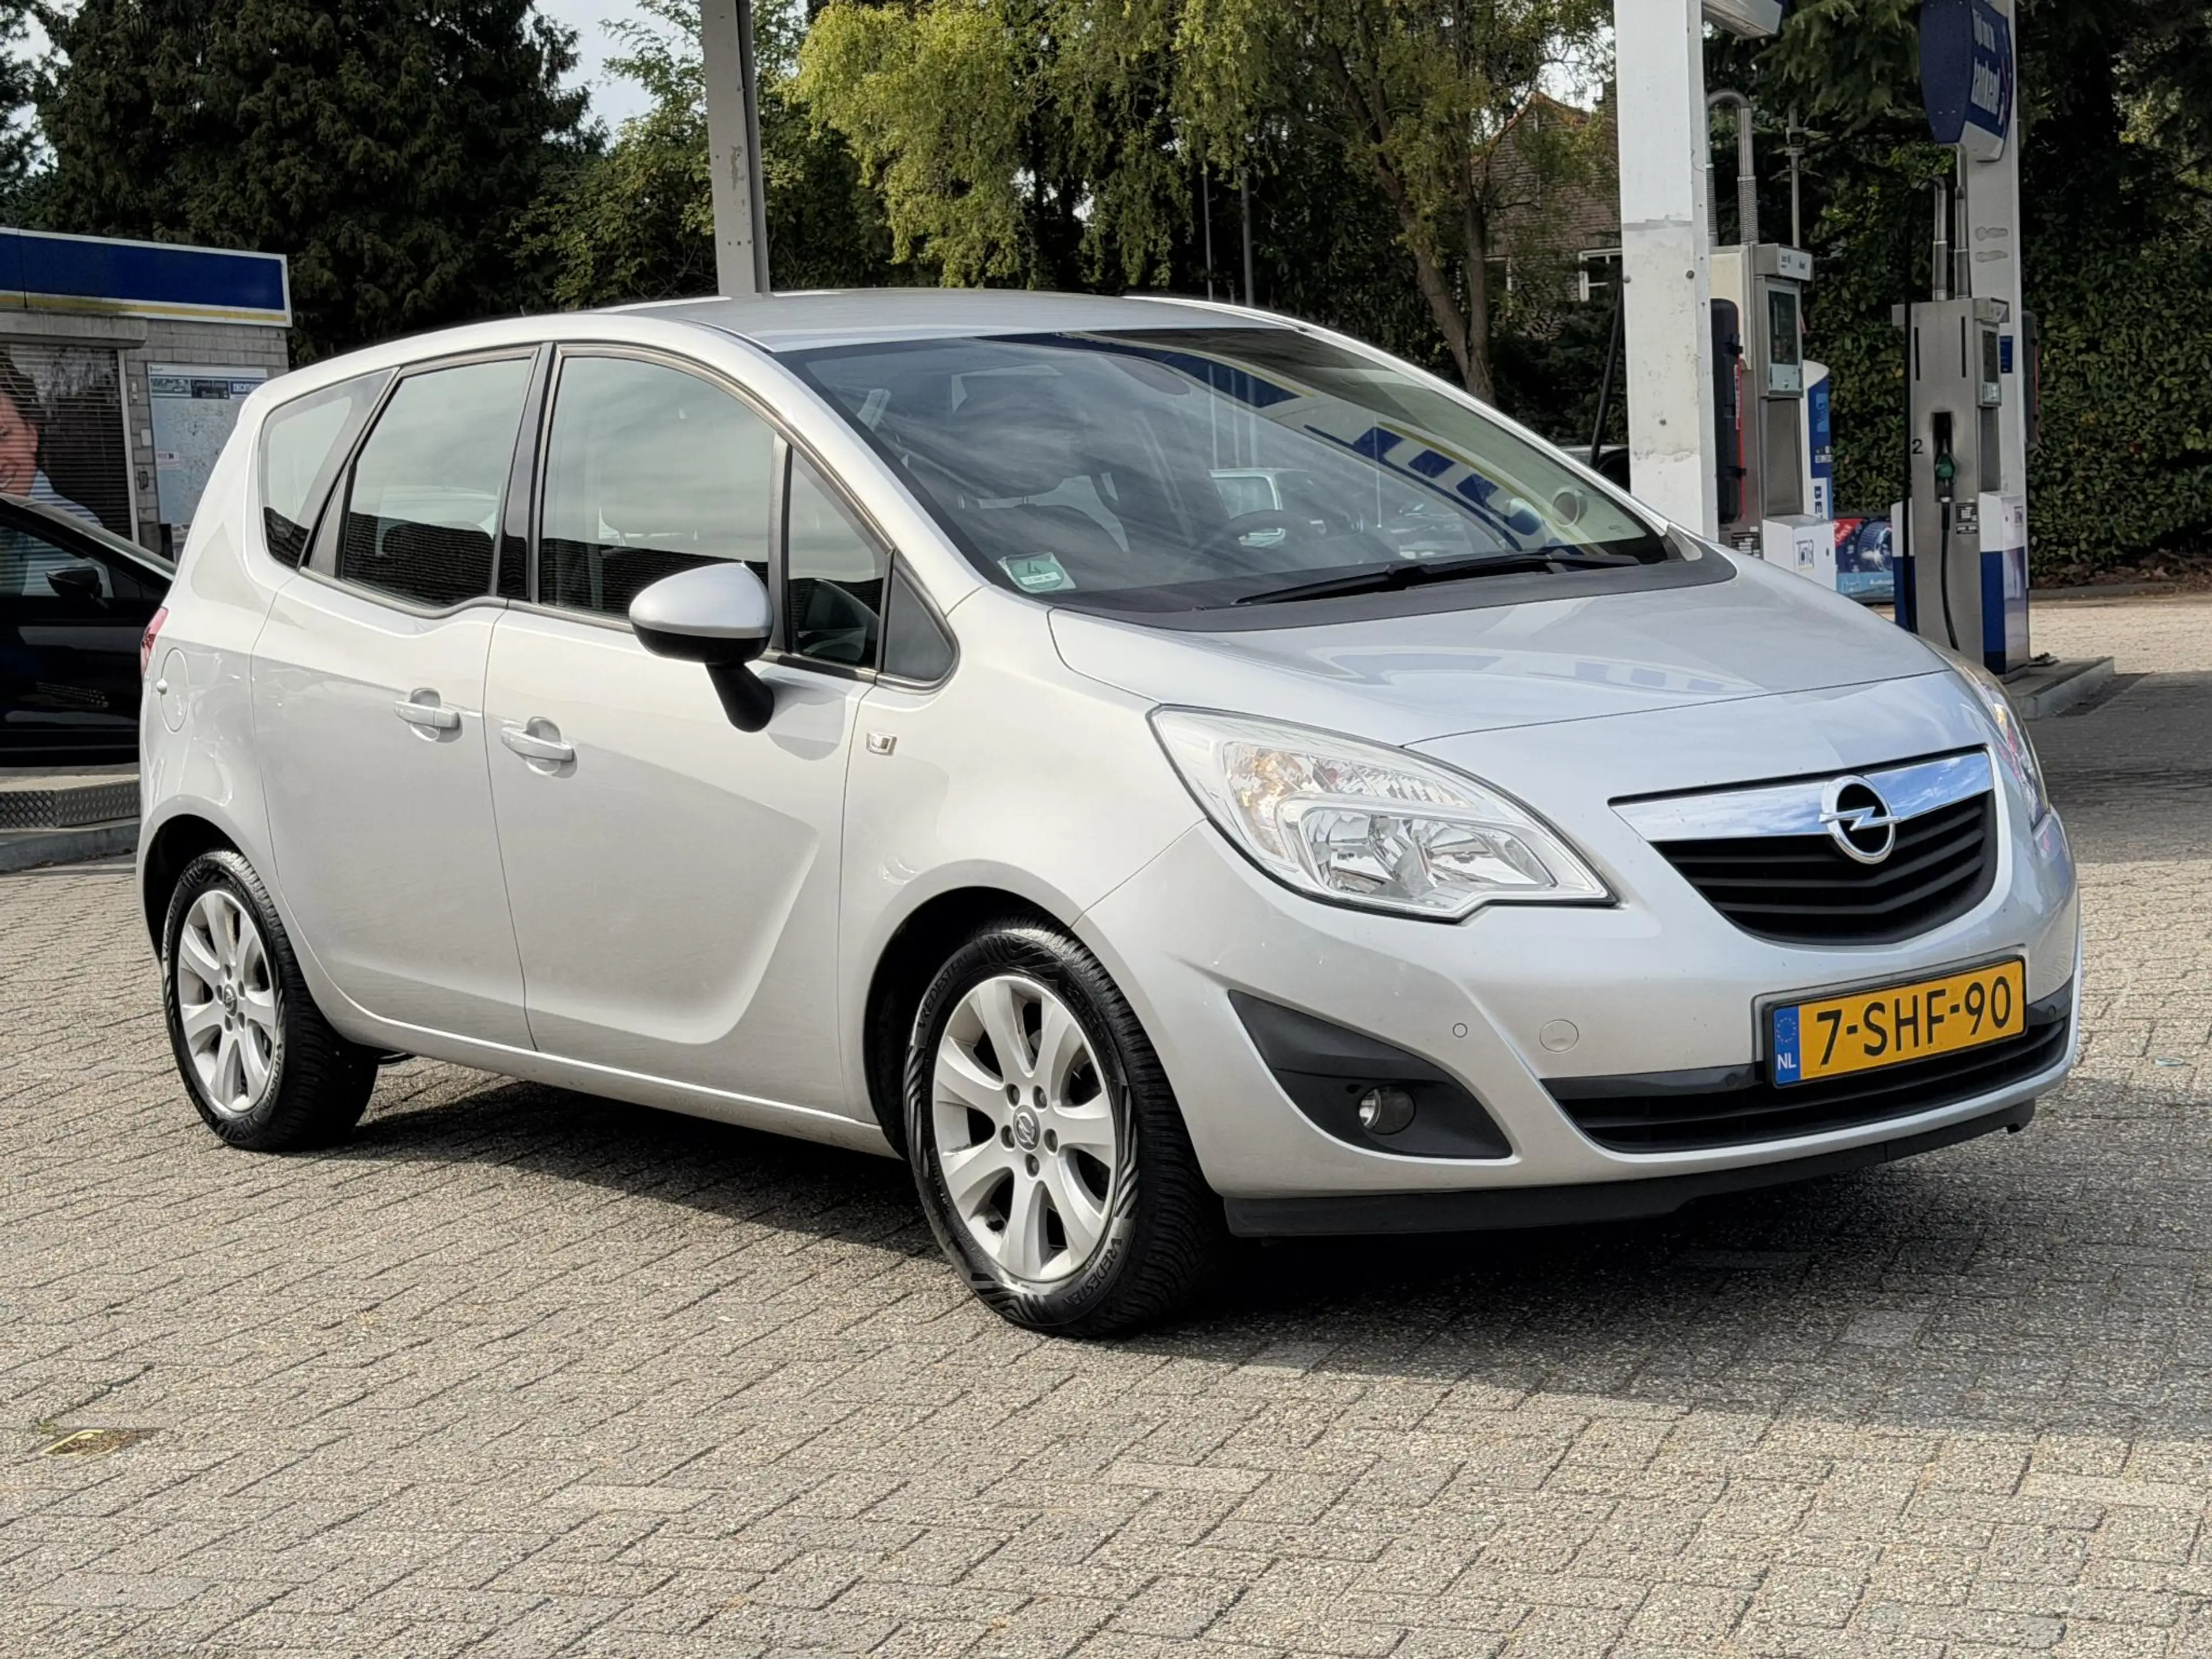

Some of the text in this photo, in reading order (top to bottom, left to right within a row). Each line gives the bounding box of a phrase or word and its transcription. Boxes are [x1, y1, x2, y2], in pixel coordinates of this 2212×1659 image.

[1912, 439, 1923, 454] 2
[1816, 976, 2012, 1066] 7-SHF-90
[1777, 1053, 1796, 1070] NL
